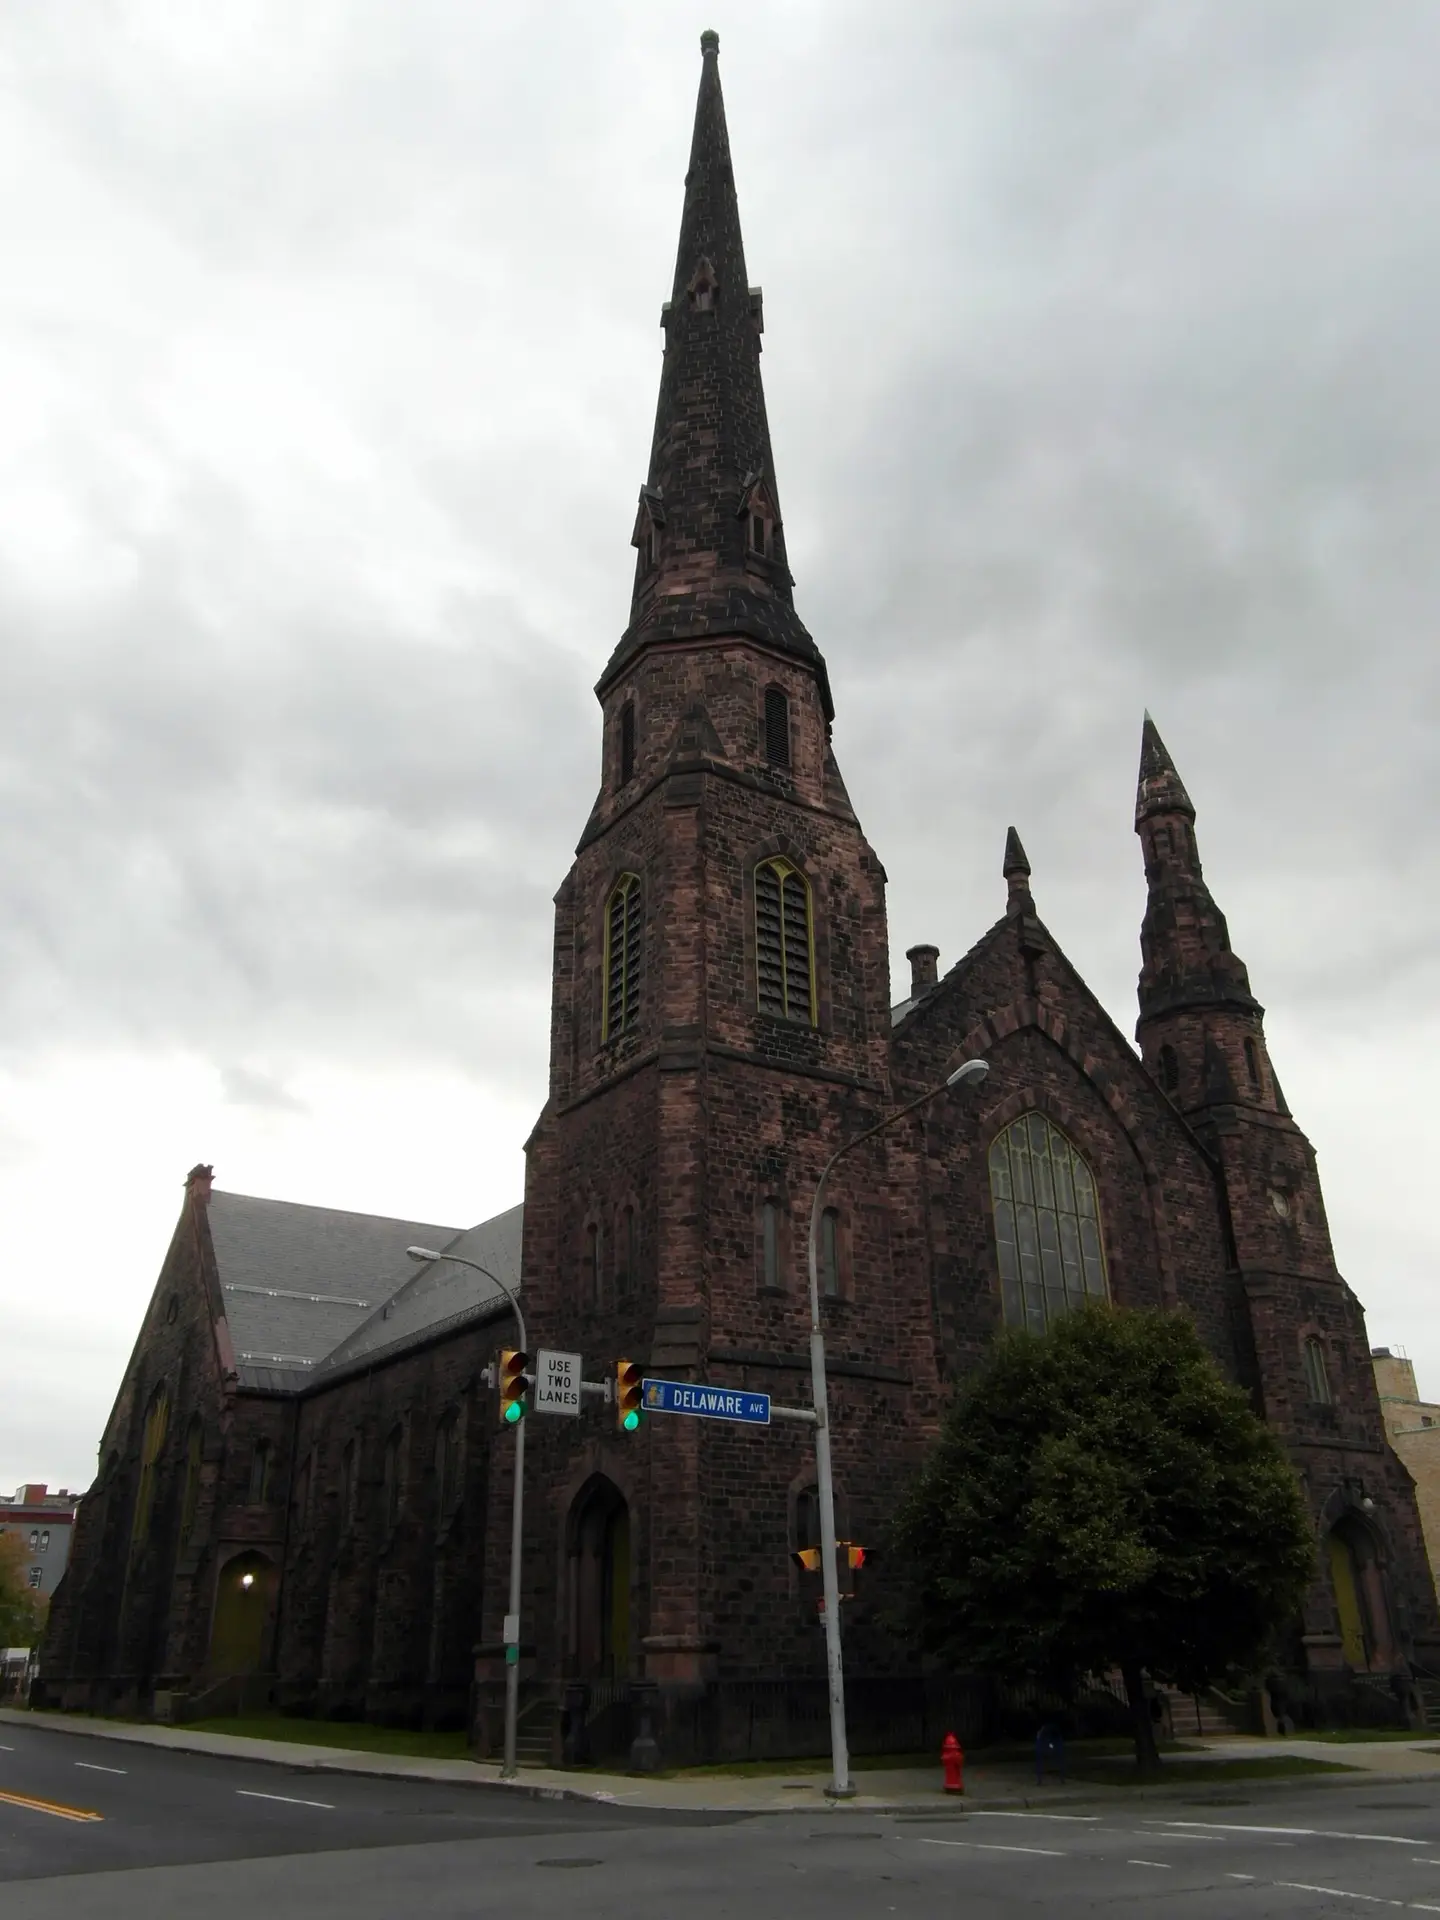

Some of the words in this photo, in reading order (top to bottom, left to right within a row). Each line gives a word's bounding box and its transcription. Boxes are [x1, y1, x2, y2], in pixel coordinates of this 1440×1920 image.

[548, 1359, 571, 1373] USE
[547, 1374, 571, 1388] TWO
[539, 1389, 578, 1405] LANES
[673, 1389, 743, 1414] DELAWARE
[749, 1403, 764, 1414] AVE
